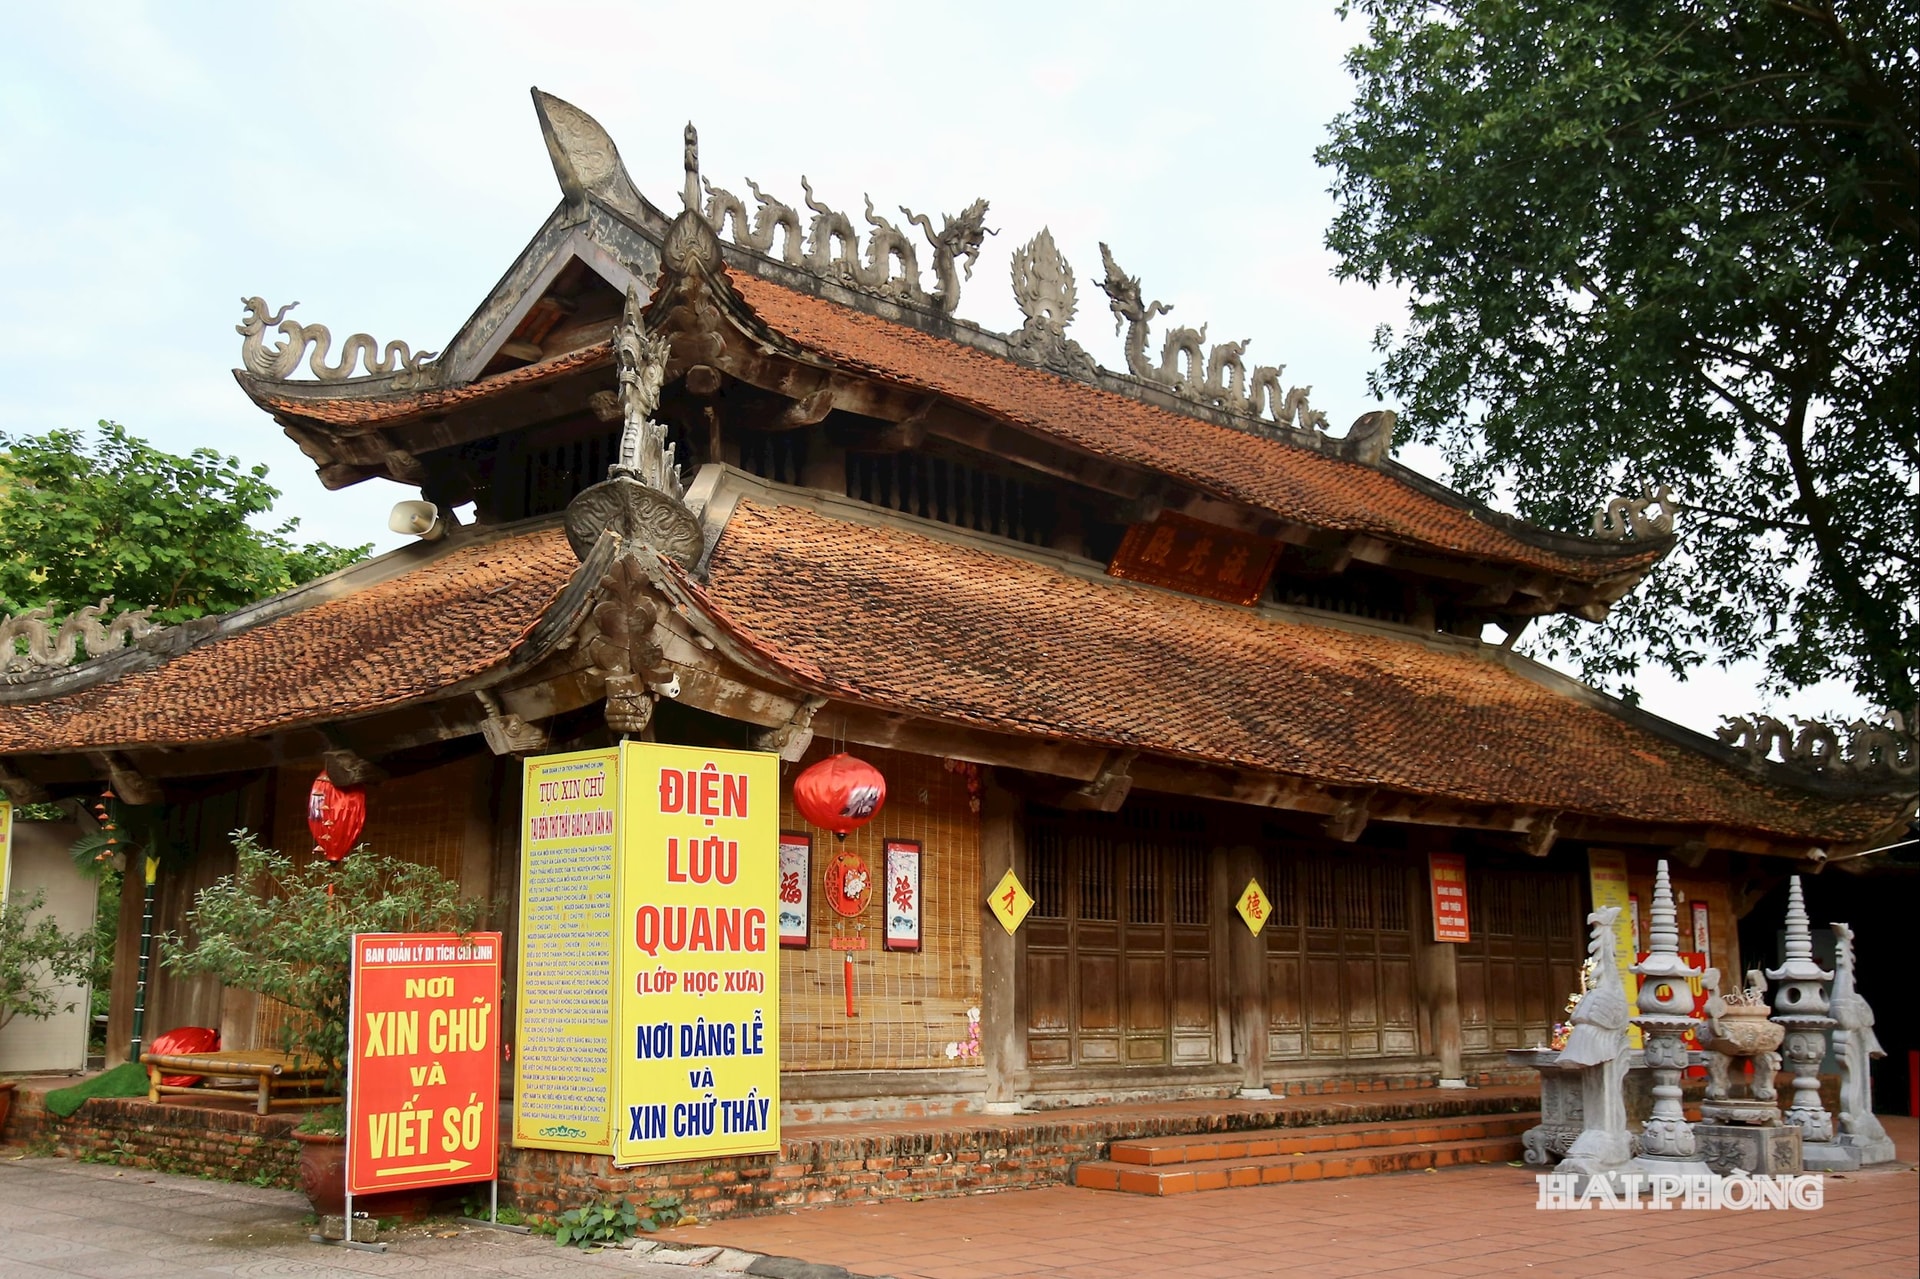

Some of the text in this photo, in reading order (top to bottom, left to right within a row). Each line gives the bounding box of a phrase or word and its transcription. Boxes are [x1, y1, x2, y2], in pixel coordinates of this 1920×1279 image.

[540, 782, 558, 807] TỤC
[562, 780, 580, 800] XIN
[659, 763, 748, 826] ĐIỆN
[668, 836, 738, 882] LƯU
[780, 872, 802, 904] 福
[1002, 886, 1016, 916] 才
[636, 905, 766, 956] QUANG
[366, 948, 384, 963] BAN
[386, 942, 410, 964] QUẢN
[413, 944, 423, 962] LÝ
[425, 947, 434, 961] DI
[436, 944, 455, 960] TÍCH
[474, 946, 492, 960] LINH
[406, 976, 454, 999] NƠI
[636, 966, 764, 996] (LỚP HỌC XƯA)
[365, 996, 492, 1058] XIN CHỮ
[637, 1010, 763, 1059] NƠI DÂNG LỄ
[410, 1061, 447, 1087] VÀ
[690, 1068, 714, 1088] VÀ
[368, 1092, 484, 1160] VIẾT SỚ
[630, 1087, 770, 1140] XIN CHỮ THẦY
